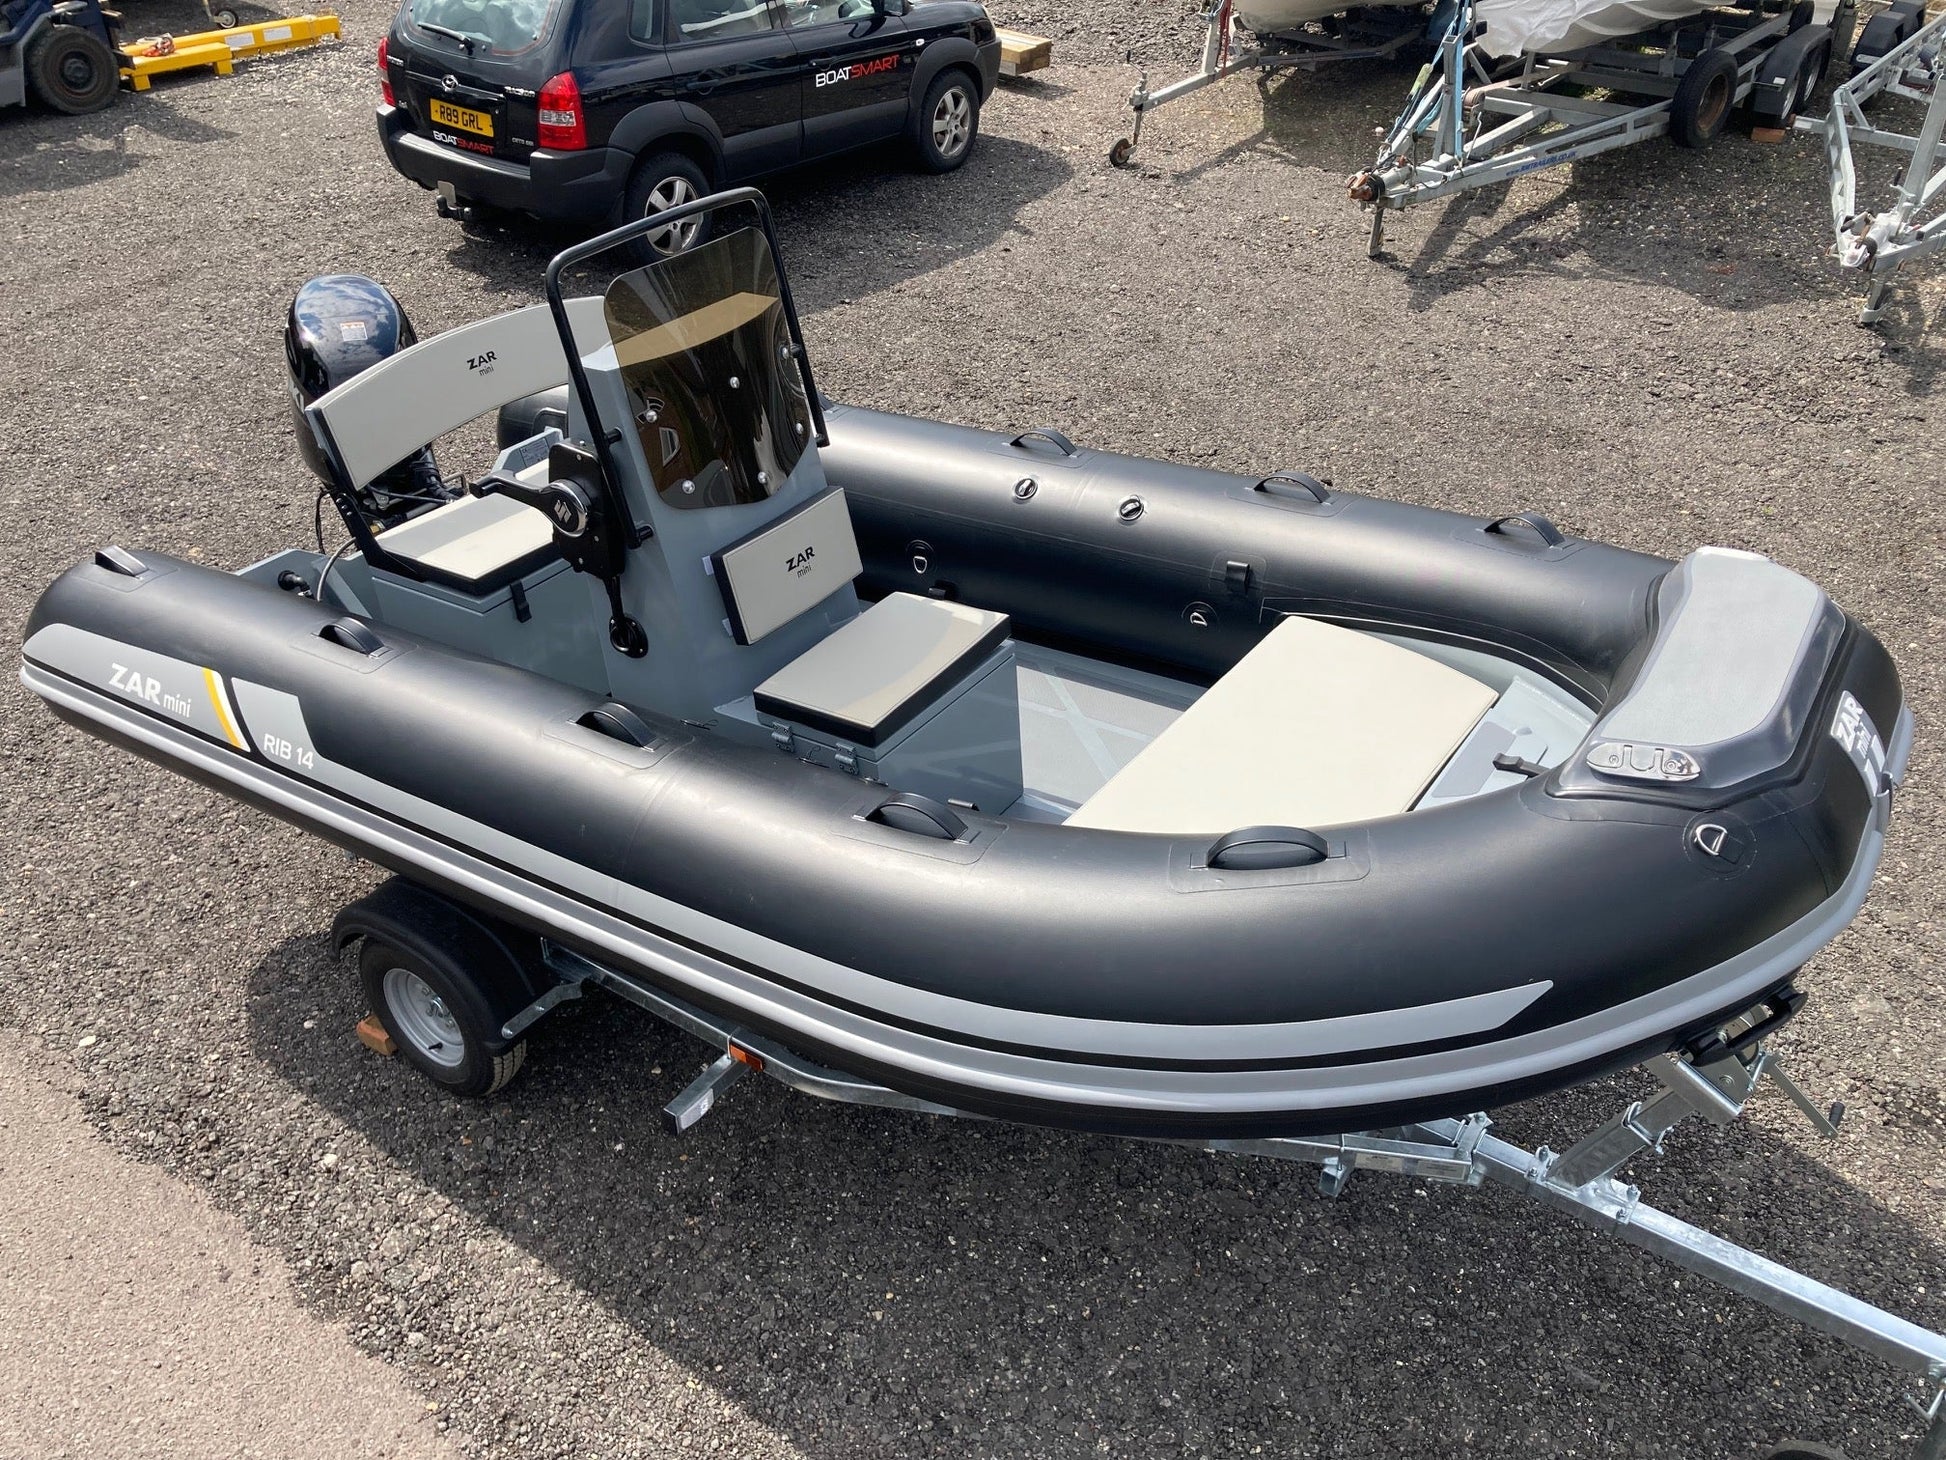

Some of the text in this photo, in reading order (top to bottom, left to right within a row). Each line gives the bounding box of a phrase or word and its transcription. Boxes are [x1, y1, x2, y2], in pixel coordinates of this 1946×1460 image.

[815, 54, 899, 88] BOATSMART
[439, 104, 483, 132] R89 GRL
[432, 130, 495, 155] BOATSMART
[466, 350, 498, 370] ZAR
[479, 363, 494, 376] mini
[785, 546, 815, 572] ZAR
[797, 562, 812, 578] mini
[108, 662, 192, 718] ZAR mini
[1836, 696, 1864, 752] ZAR
[263, 733, 314, 770] RIB 14
